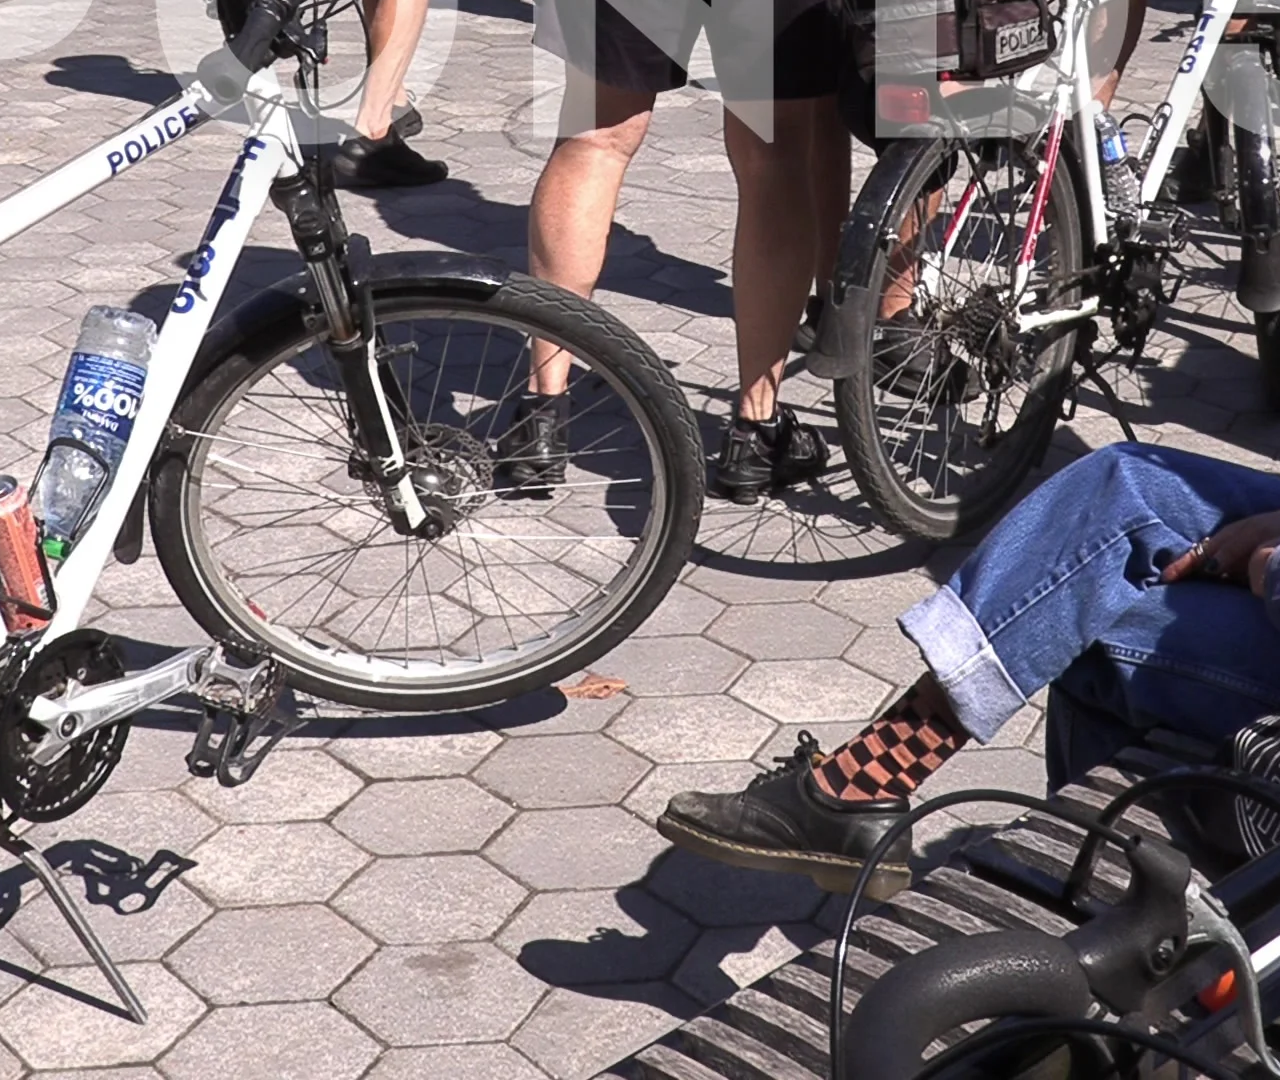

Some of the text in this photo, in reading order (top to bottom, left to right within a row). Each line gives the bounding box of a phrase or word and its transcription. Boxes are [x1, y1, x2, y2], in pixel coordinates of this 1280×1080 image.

[1000, 24, 1044, 55] POLIC
[106, 104, 200, 177] POLICE
[73, 382, 137, 420] 100%
